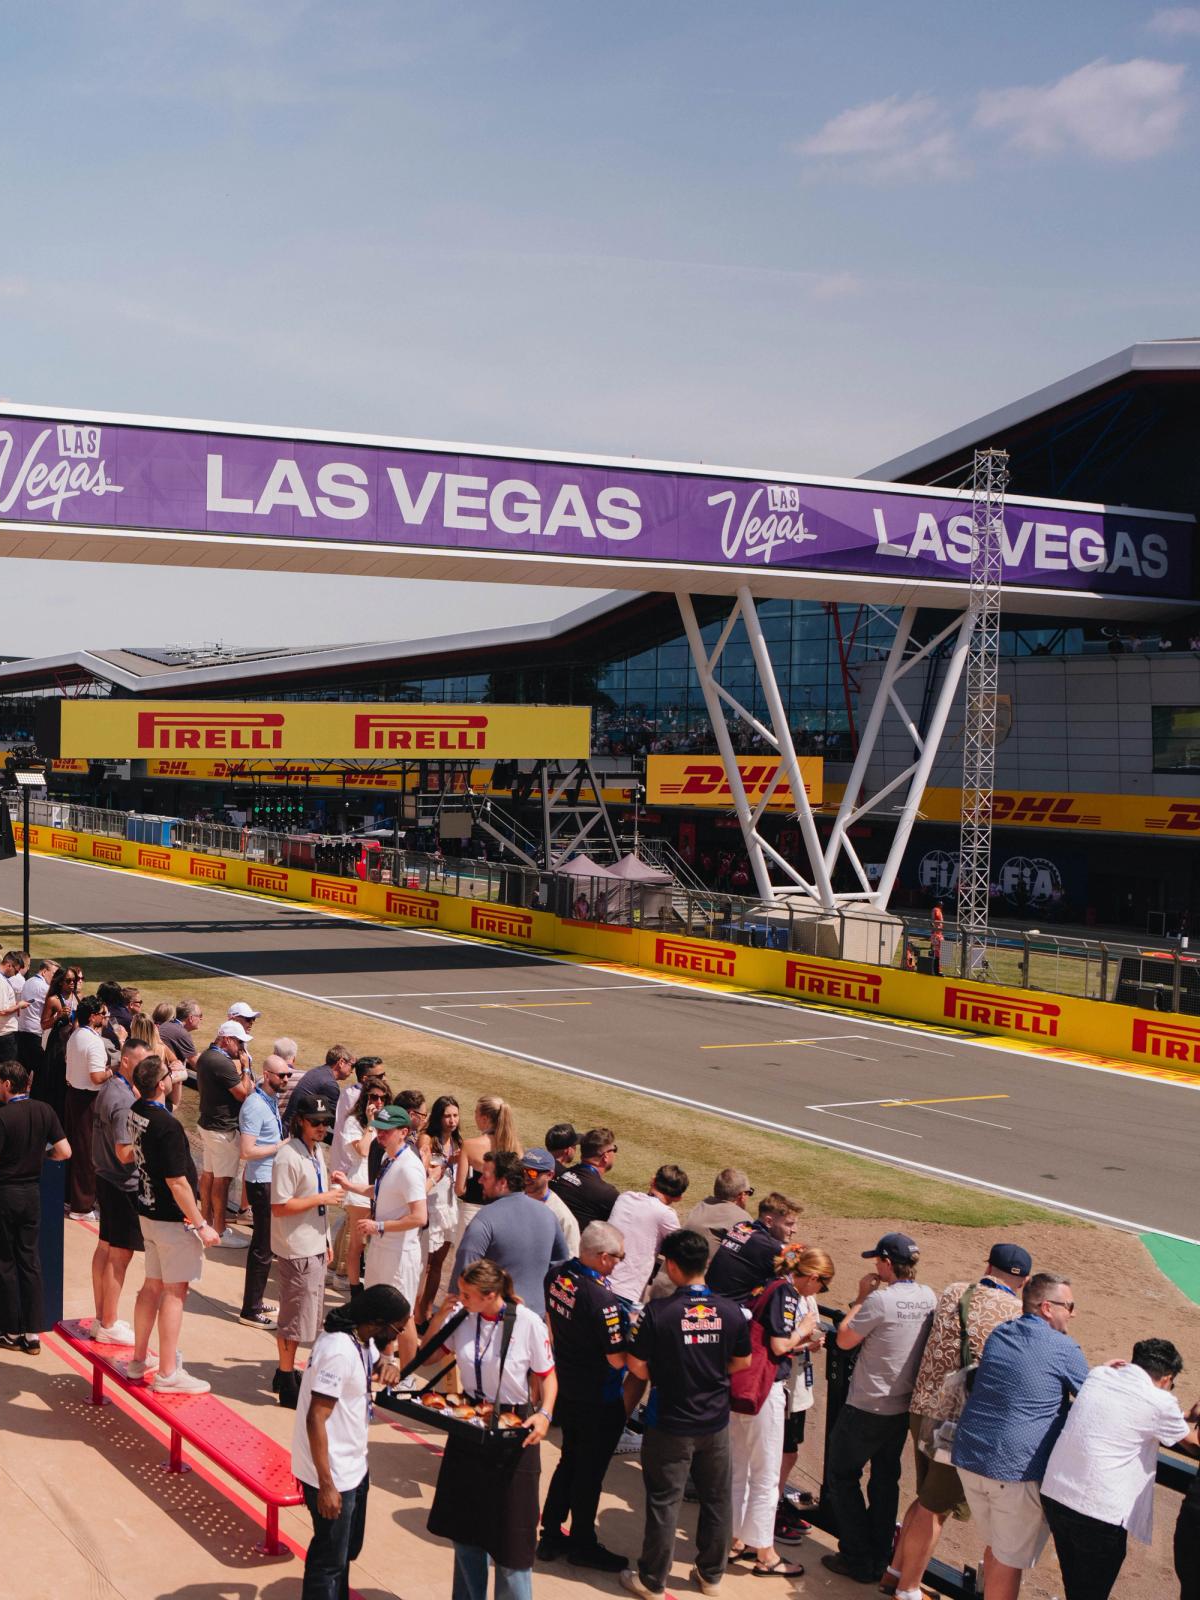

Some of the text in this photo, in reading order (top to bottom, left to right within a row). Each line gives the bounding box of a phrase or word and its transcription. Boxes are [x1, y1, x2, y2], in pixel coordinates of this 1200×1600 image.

[61, 428, 98, 454] LAS
[206, 454, 643, 541] LAS VEGAS
[771, 487, 799, 510] LAS
[873, 508, 1168, 579] LAS VEGAS
[138, 712, 285, 749] PIRELLI
[355, 714, 488, 750] PIRELLI
[159, 761, 190, 775] DHL
[681, 766, 791, 794] DHL
[979, 796, 1080, 824] DHL
[52, 833, 78, 852] PIRELLI
[93, 841, 122, 861] PIRELLI
[138, 849, 170, 871] PIRELLI
[190, 857, 226, 880] PIRELLI
[247, 867, 288, 892] PIRELLI
[311, 878, 358, 905] PIRELLI
[386, 892, 439, 922] PIRELLI
[471, 906, 533, 939] PIRELLI
[656, 938, 737, 977] PIRELLI
[786, 960, 883, 1004] PIRELLI
[944, 987, 1061, 1036] PIRELLI
[316, 1099, 326, 1111] L
[681, 1318, 722, 1331] Red Bull
[684, 1334, 709, 1344] Mobil
